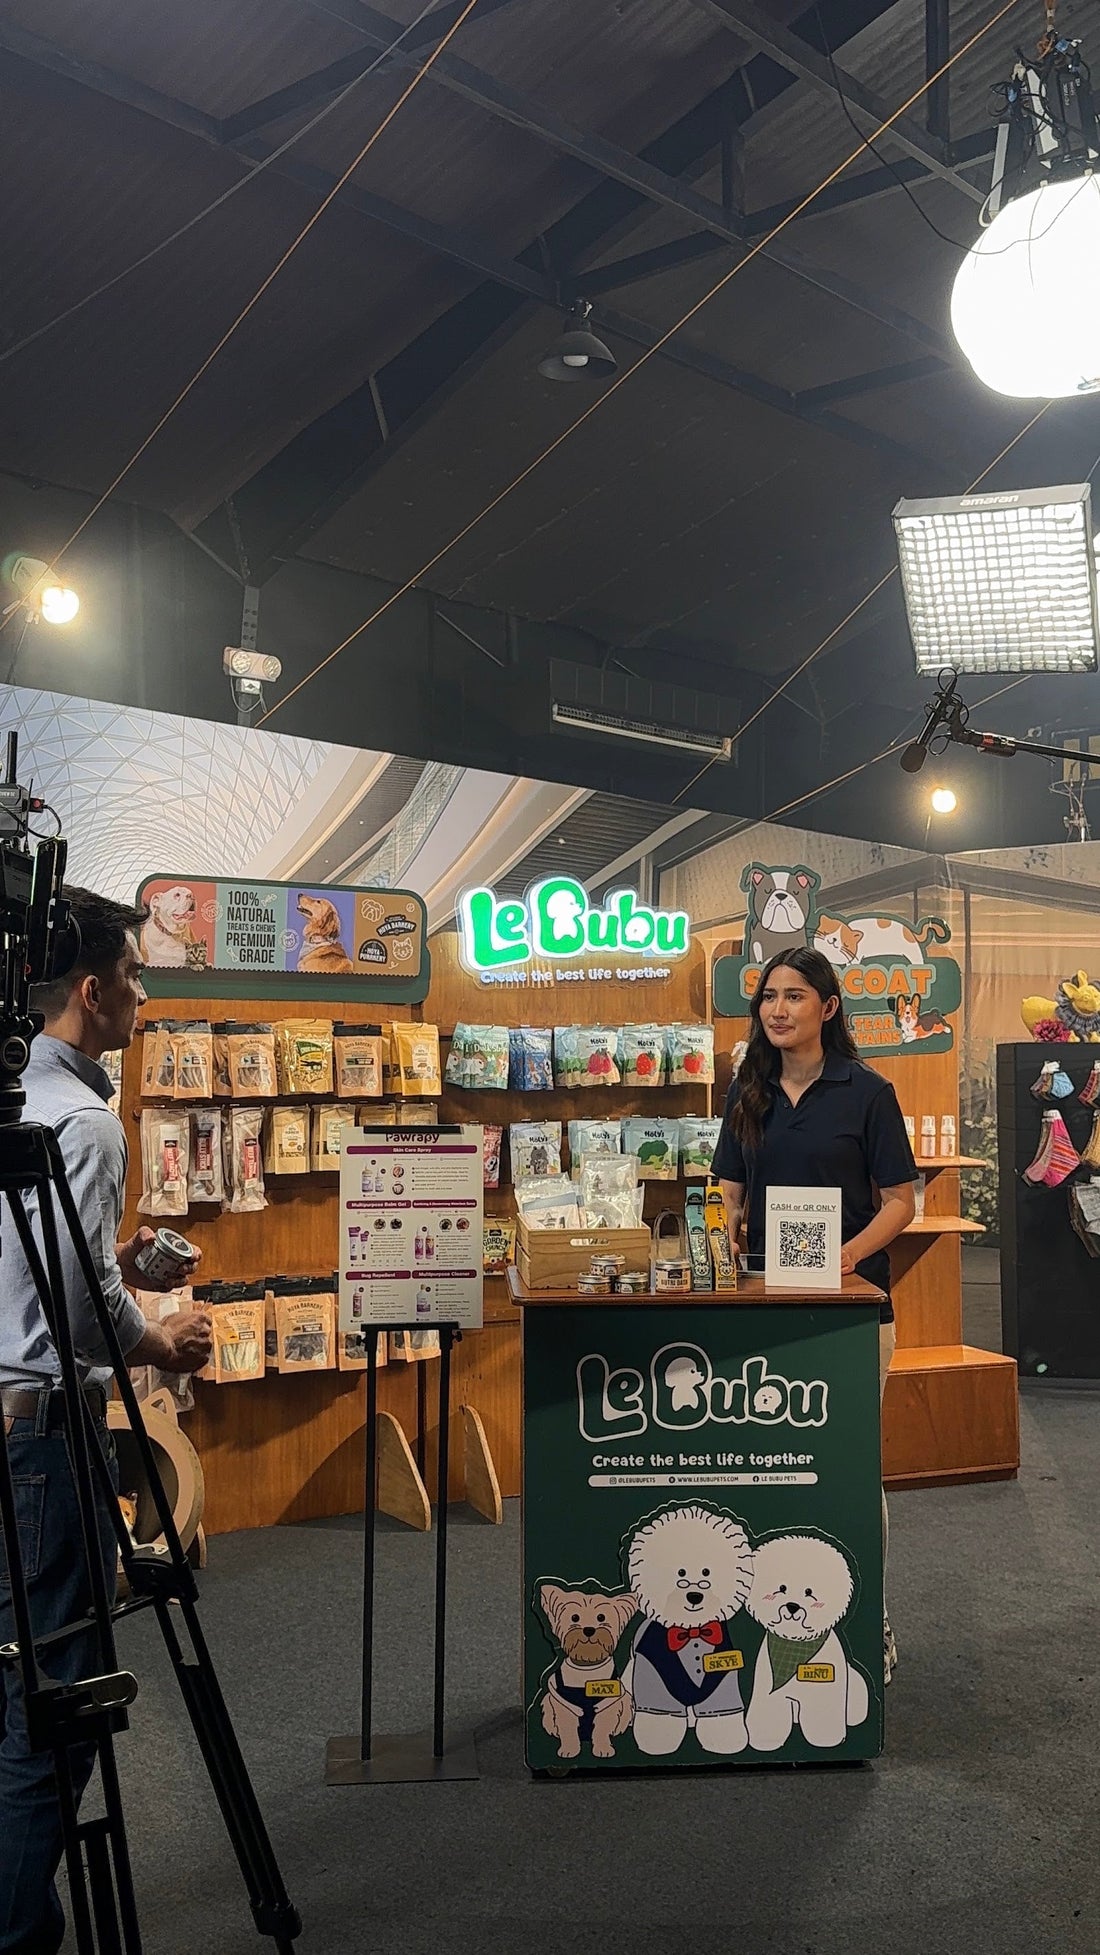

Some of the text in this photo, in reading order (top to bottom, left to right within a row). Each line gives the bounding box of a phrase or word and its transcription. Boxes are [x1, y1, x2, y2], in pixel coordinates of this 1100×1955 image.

[959, 495, 1019, 506] amaran
[228, 890, 259, 907] 100%
[227, 906, 276, 923] NATURAL
[227, 922, 276, 932] TREATS & CHEWS
[465, 878, 688, 969] Le Bubu
[226, 932, 276, 948] PREMIUM
[239, 948, 275, 963] GRADE
[480, 967, 670, 983] Create the best life together
[843, 968, 933, 995] COAT
[854, 1016, 894, 1031] TEAR
[386, 1133, 440, 1144] Pawrapy
[576, 1341, 829, 1443] Le Bubu
[592, 1452, 814, 1468] Create the best life together
[677, 1475, 739, 1484] WWW.LEBUBUPETS.COM
[761, 1475, 767, 1483] LE
[768, 1475, 784, 1483] BUBU
[708, 1657, 739, 1670] SKYE
[803, 1670, 829, 1679] BINU
